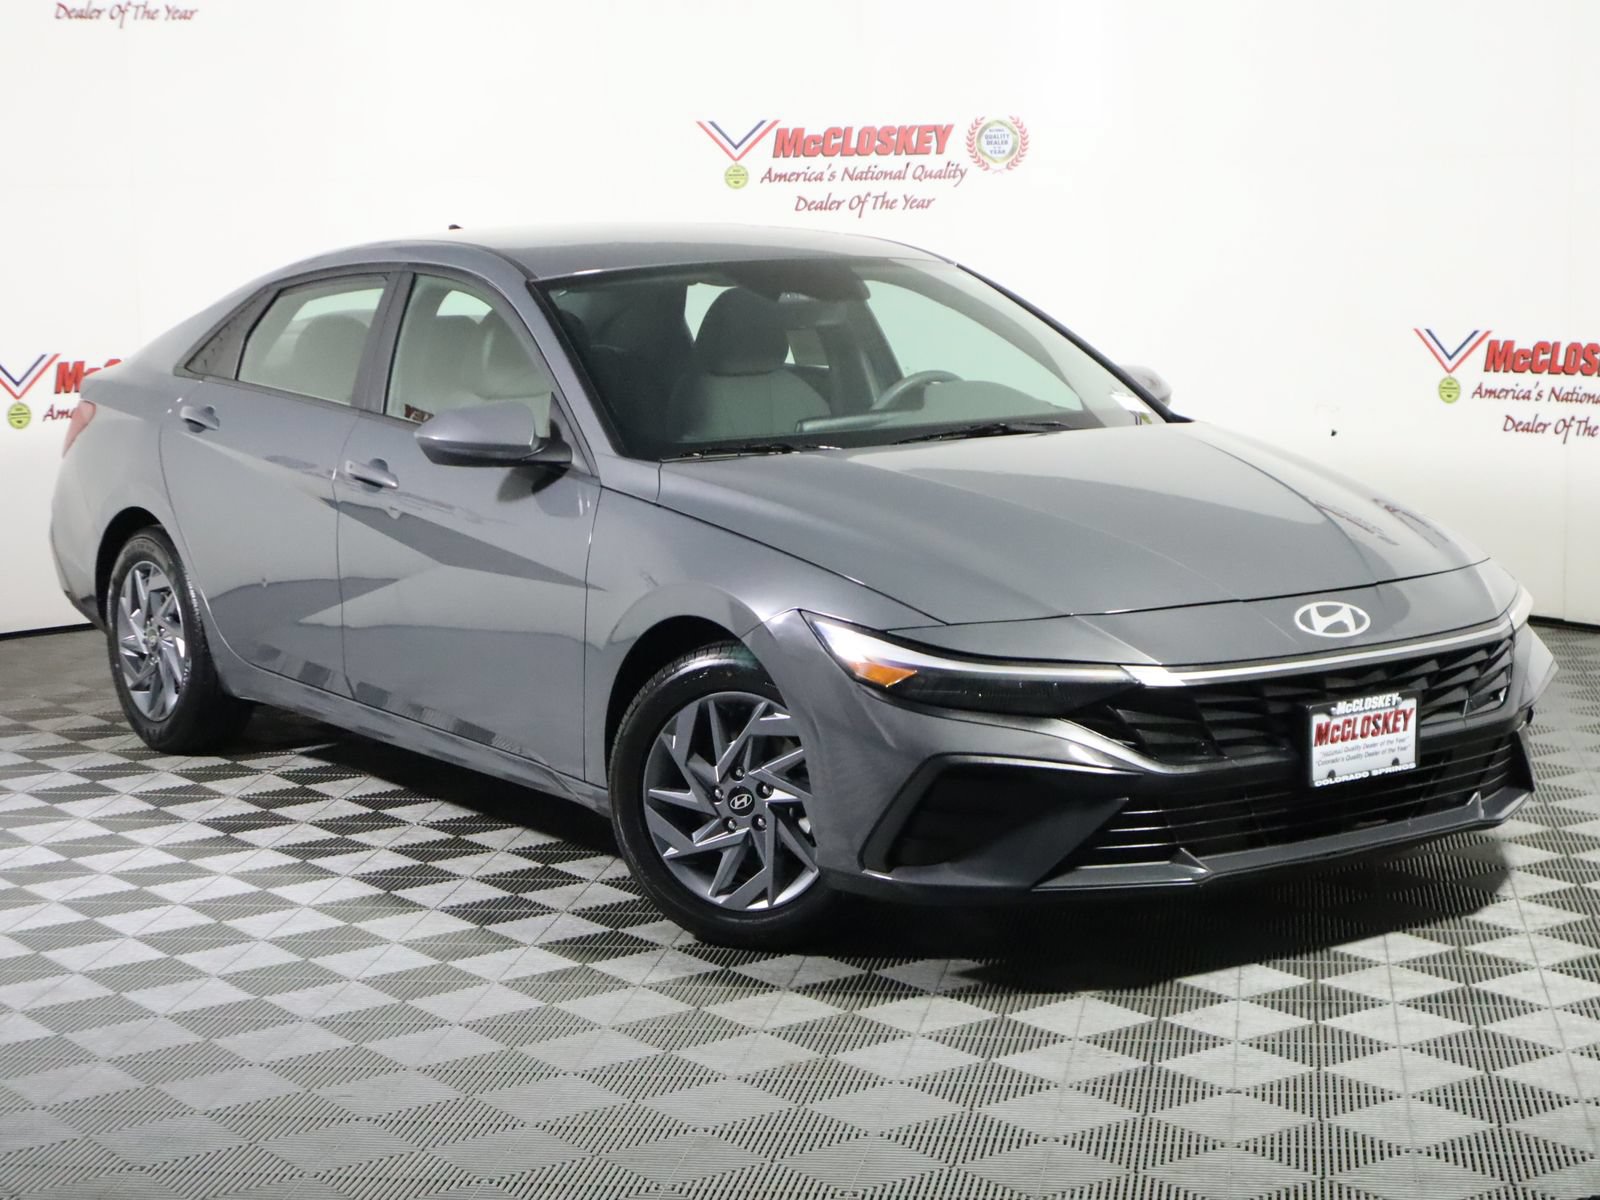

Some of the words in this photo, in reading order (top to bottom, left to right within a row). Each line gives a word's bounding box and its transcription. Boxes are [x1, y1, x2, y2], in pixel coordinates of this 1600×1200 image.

[55, 0, 105, 19] Dealer
[109, 0, 131, 28] Of
[133, 0, 159, 20] The
[164, 4, 199, 20] Year
[772, 124, 954, 158] McCLOSKEY
[760, 164, 837, 184] America's
[841, 162, 911, 182] National
[912, 161, 968, 187] Quality
[794, 193, 845, 211] Dealer
[848, 192, 872, 218] Of
[872, 192, 900, 210] The
[902, 194, 935, 210] Year
[1483, 339, 1600, 377] McCLOS
[1471, 382, 1543, 402] America's
[1503, 414, 1551, 434] Dealer
[1554, 416, 1576, 445] Of
[1576, 416, 1599, 437] The
[1336, 693, 1399, 714] McCLOSKEY
[1314, 708, 1414, 747] McCLOSKEY
[1314, 771, 1369, 787] COLORADO
[1371, 762, 1416, 776] SPRINGS
